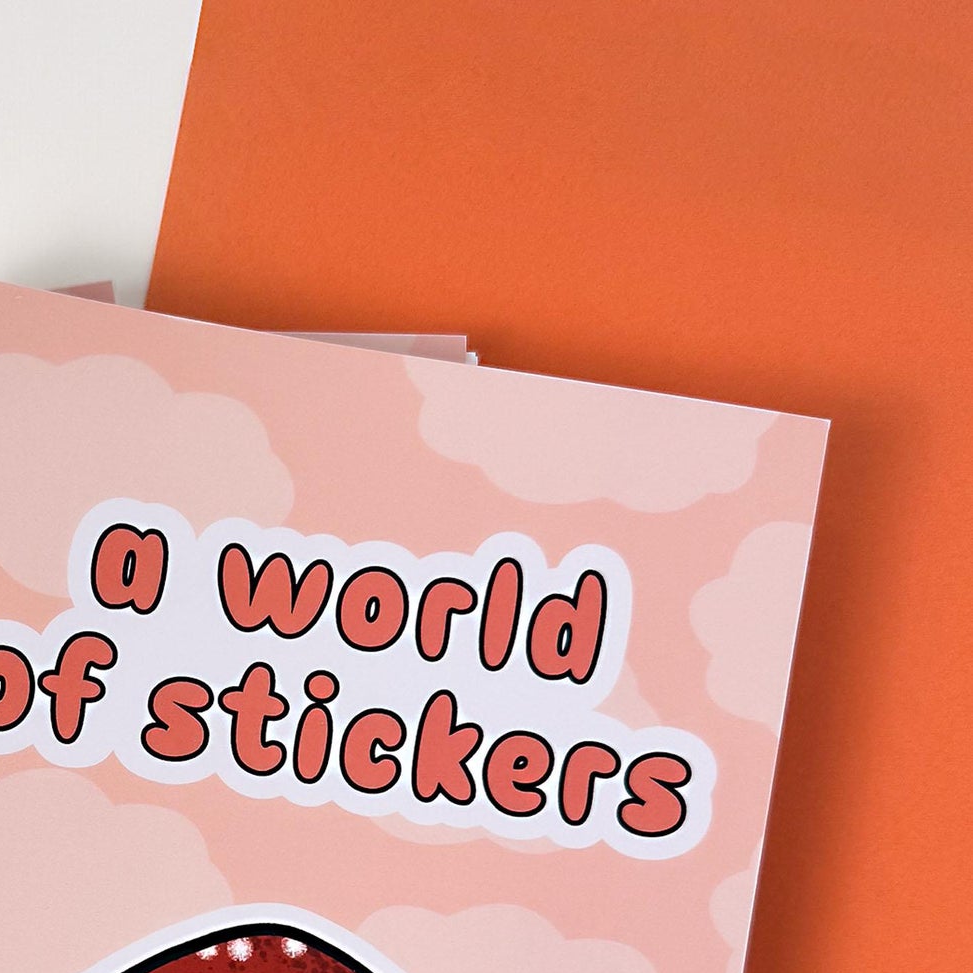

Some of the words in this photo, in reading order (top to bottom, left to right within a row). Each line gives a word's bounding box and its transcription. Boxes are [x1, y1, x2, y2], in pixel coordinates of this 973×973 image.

[90, 522, 169, 615] a
[217, 542, 607, 685] world
[140, 661, 693, 837] stickers
